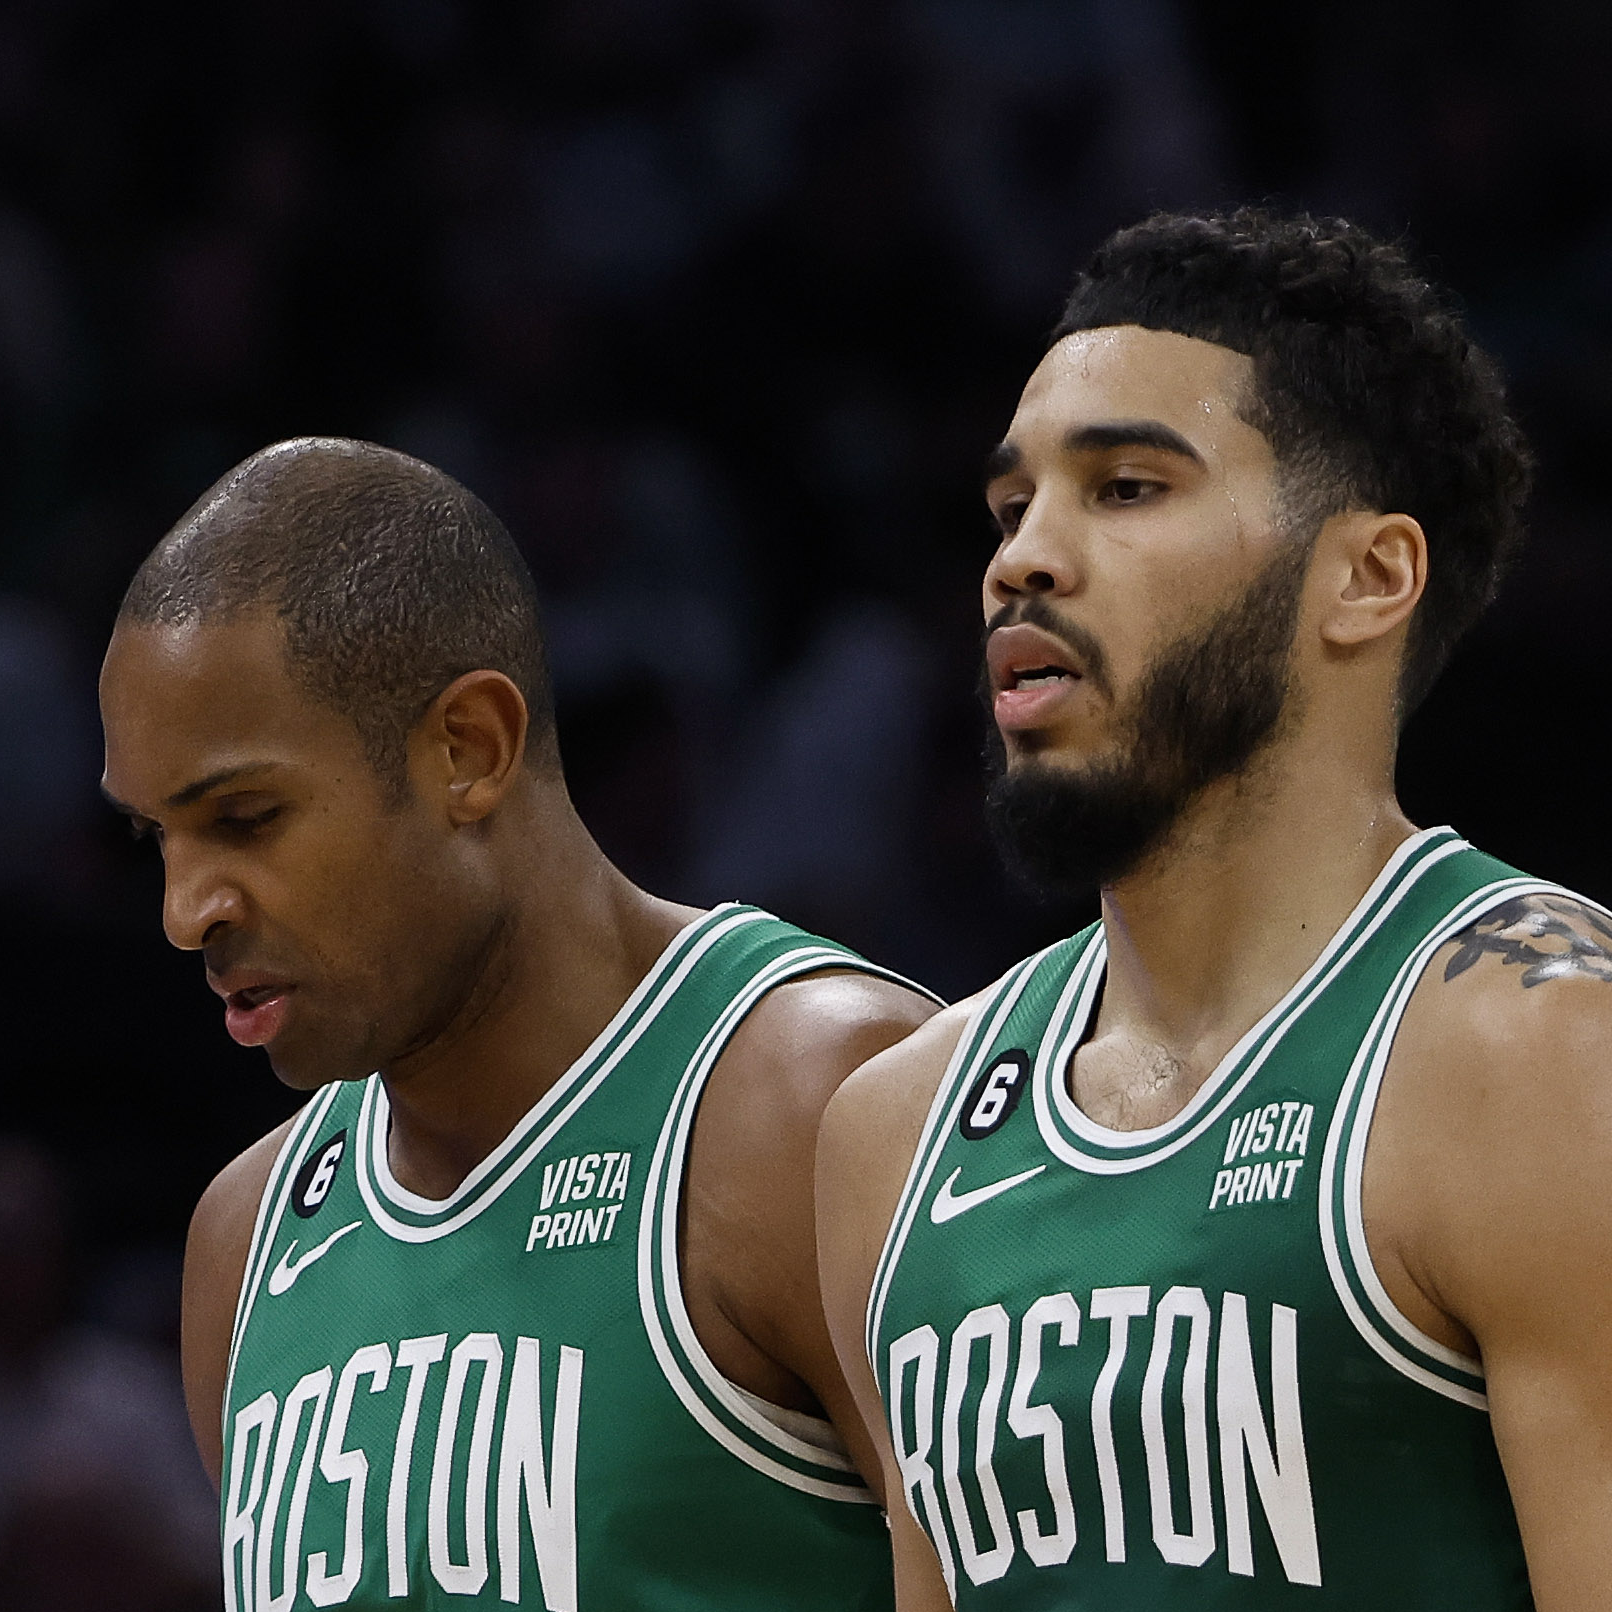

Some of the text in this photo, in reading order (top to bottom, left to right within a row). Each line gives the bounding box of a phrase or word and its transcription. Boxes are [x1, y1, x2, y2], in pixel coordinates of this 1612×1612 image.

[968, 1063, 1020, 1128] 6
[1223, 1101, 1314, 1166] VISTA
[303, 1141, 344, 1207] 6
[539, 1151, 632, 1211] VISTA
[1208, 1158, 1304, 1210] PRINT
[525, 1202, 624, 1252] PRINT
[889, 1285, 1323, 1612] BOSTON
